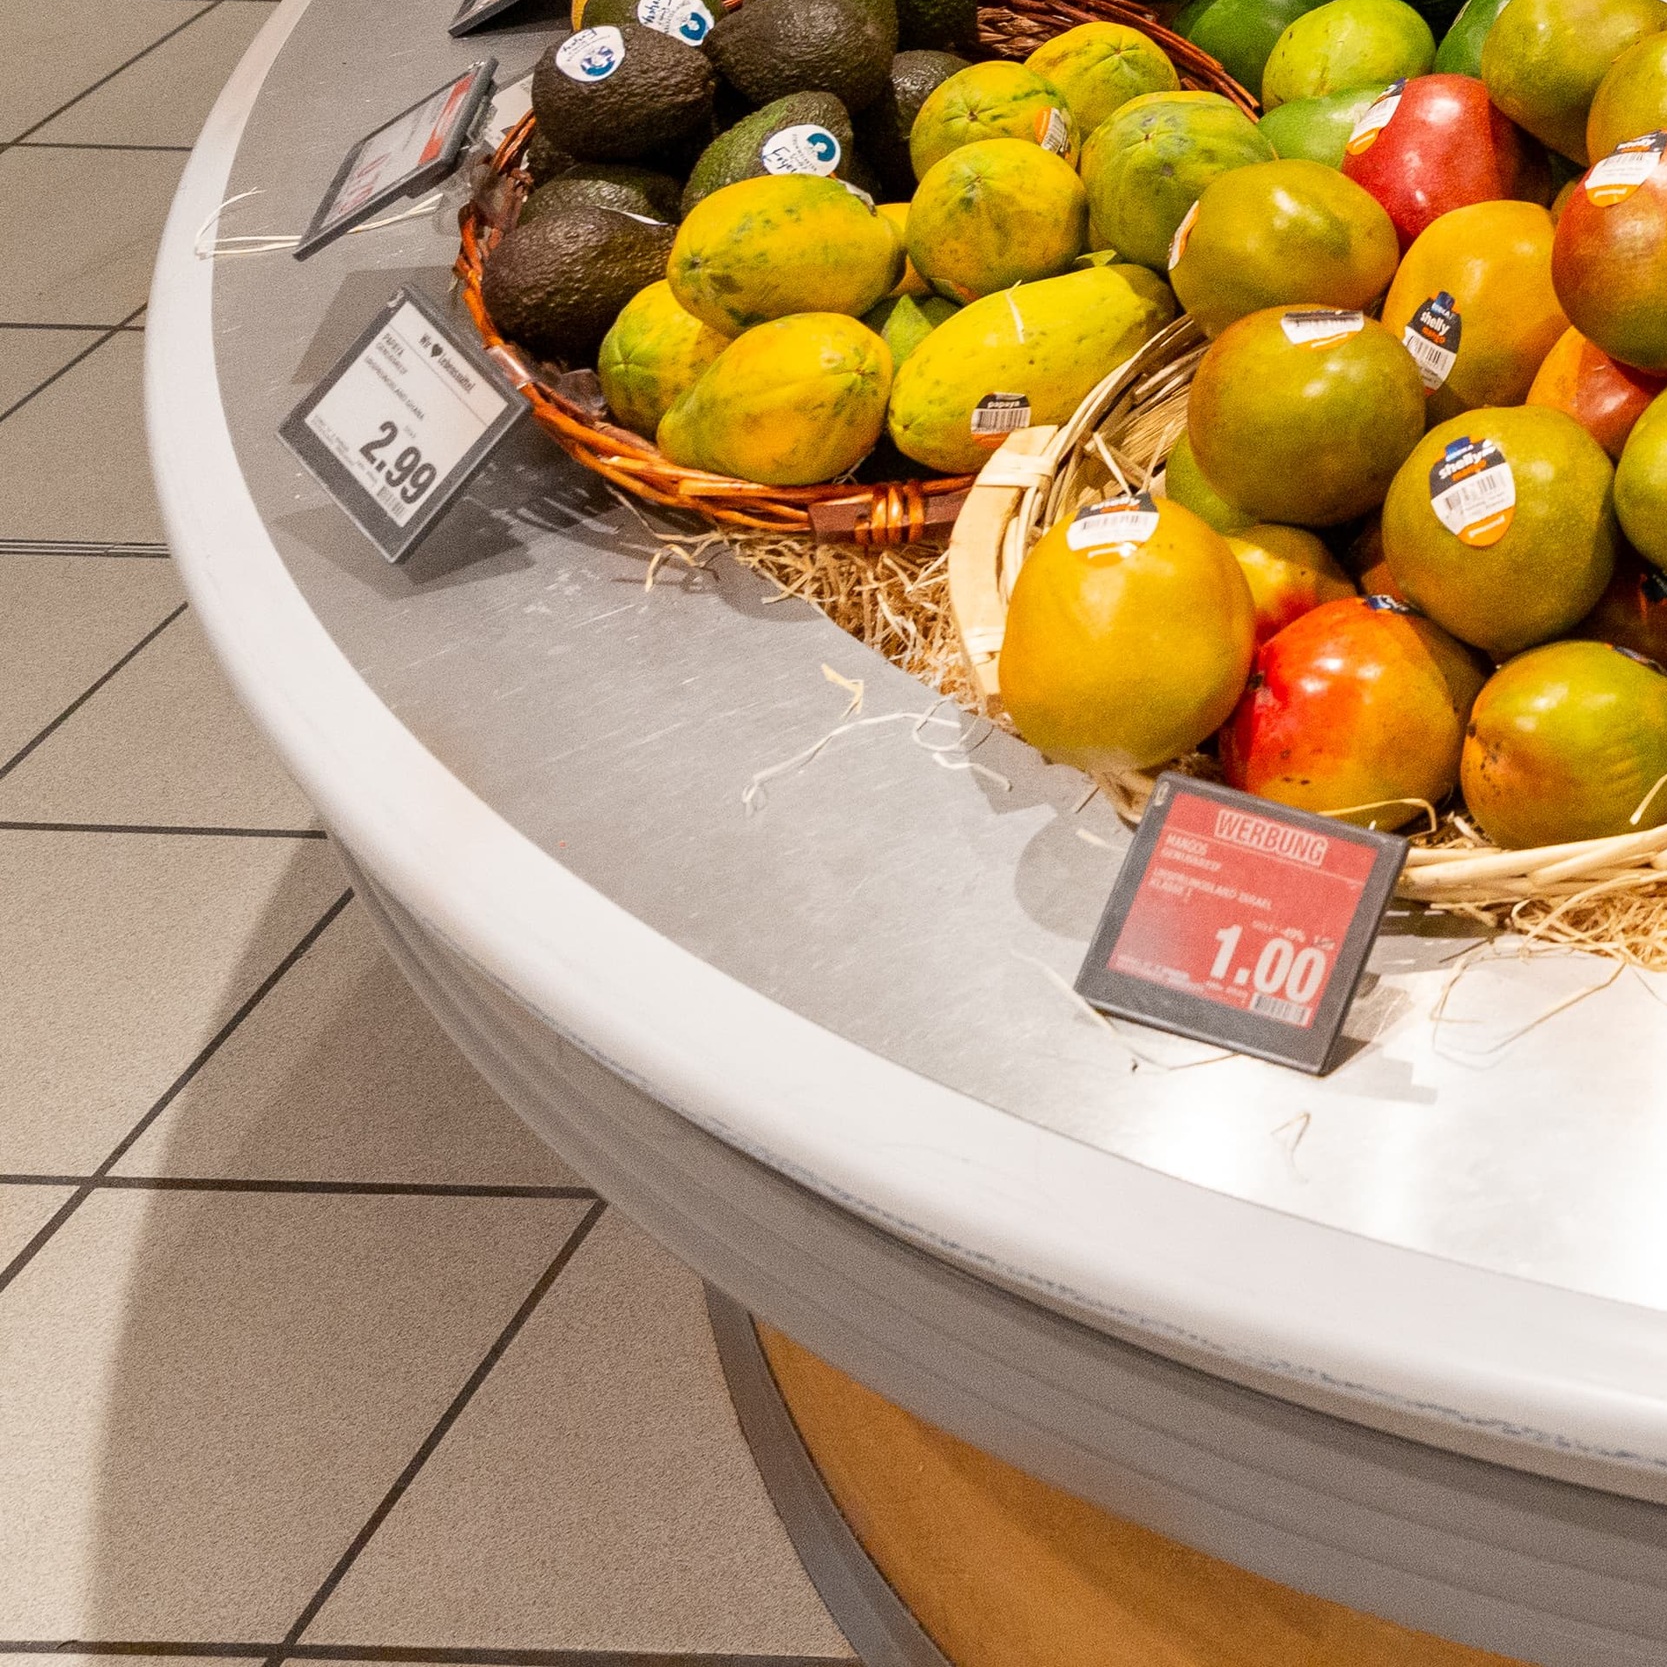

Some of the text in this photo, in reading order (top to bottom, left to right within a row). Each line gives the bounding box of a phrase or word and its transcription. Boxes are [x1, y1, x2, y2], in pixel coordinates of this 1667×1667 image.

[1419, 311, 1451, 336] shelly
[359, 420, 437, 506] 2.99
[1438, 451, 1482, 480] shelly
[1214, 808, 1330, 869] WERBUNG
[1210, 924, 1327, 1004] 1.00
